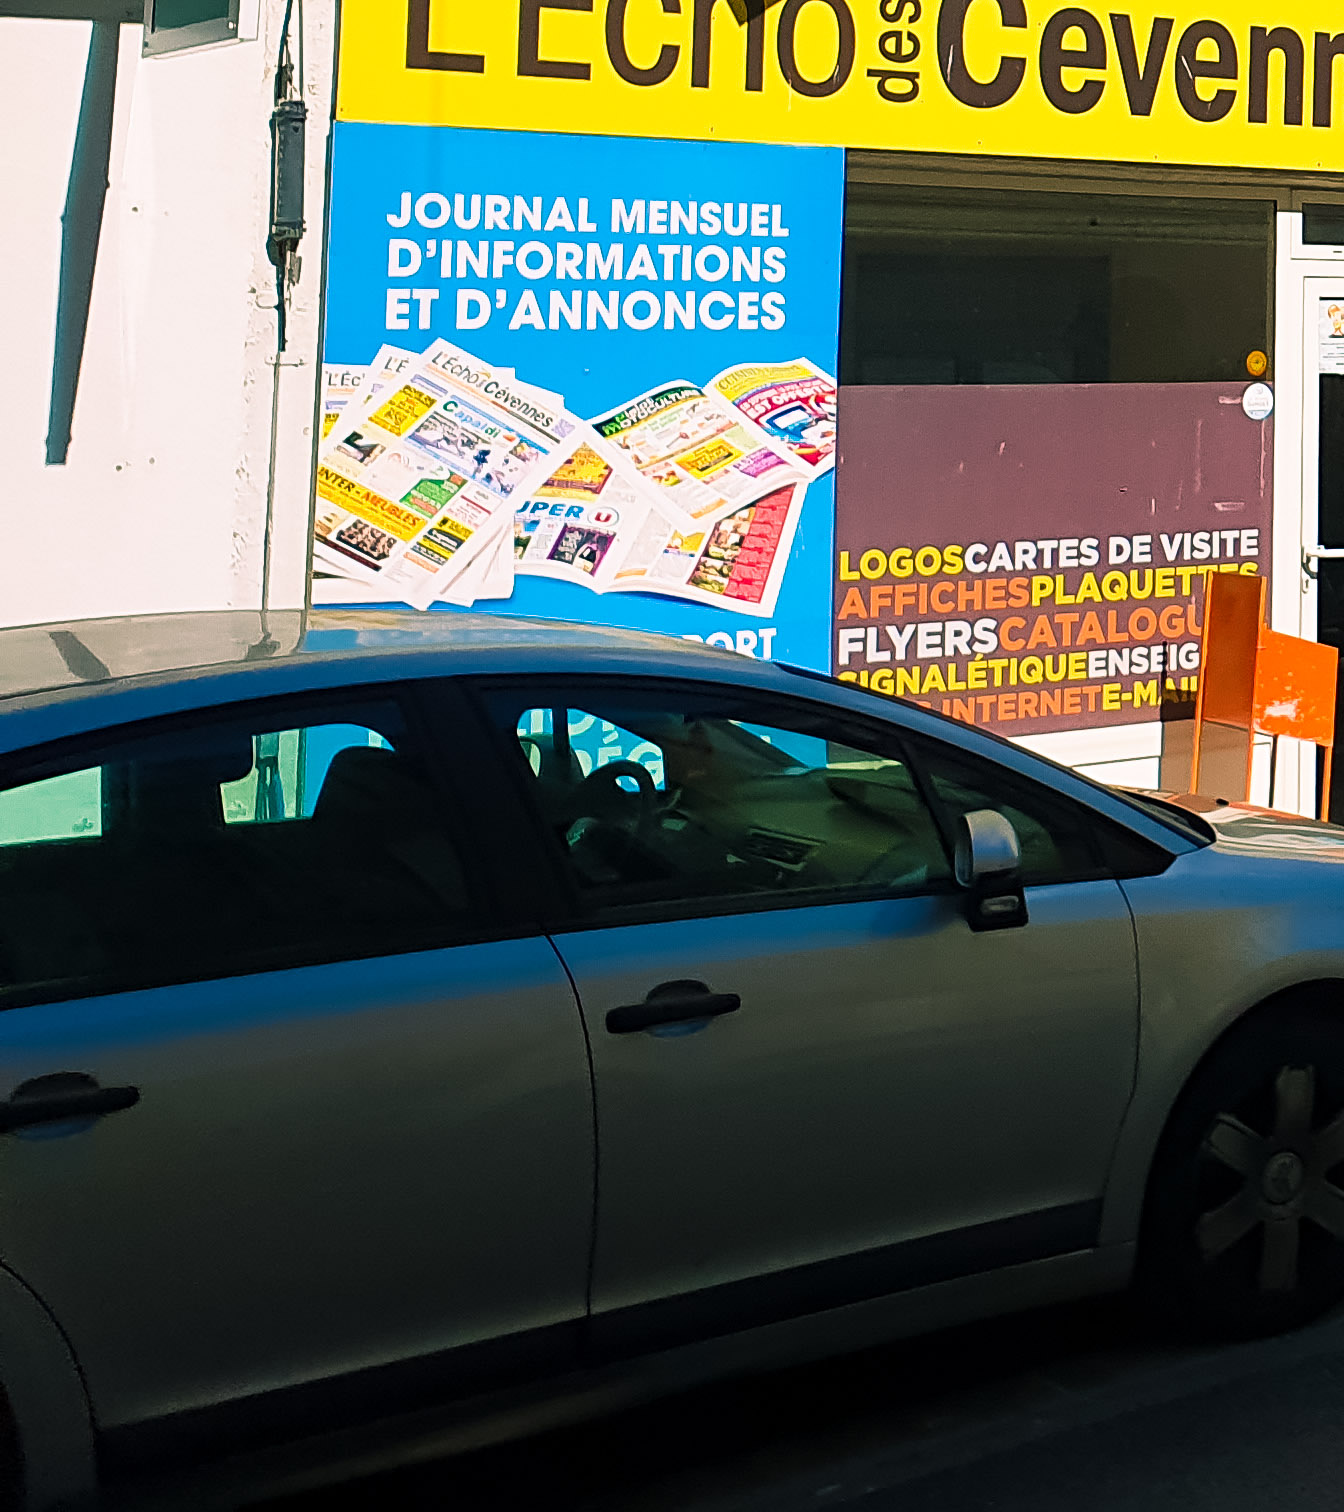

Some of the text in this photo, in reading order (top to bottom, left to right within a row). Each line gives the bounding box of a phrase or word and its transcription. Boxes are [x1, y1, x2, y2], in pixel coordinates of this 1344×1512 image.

[387, 191, 789, 237] JOURNAL MENSUEL
[387, 239, 786, 283] D'INFORMATIONS
[385, 289, 786, 331] ET D'ANNONCES
[1108, 534, 1152, 566] DE
[1159, 528, 1260, 563] VISITE
